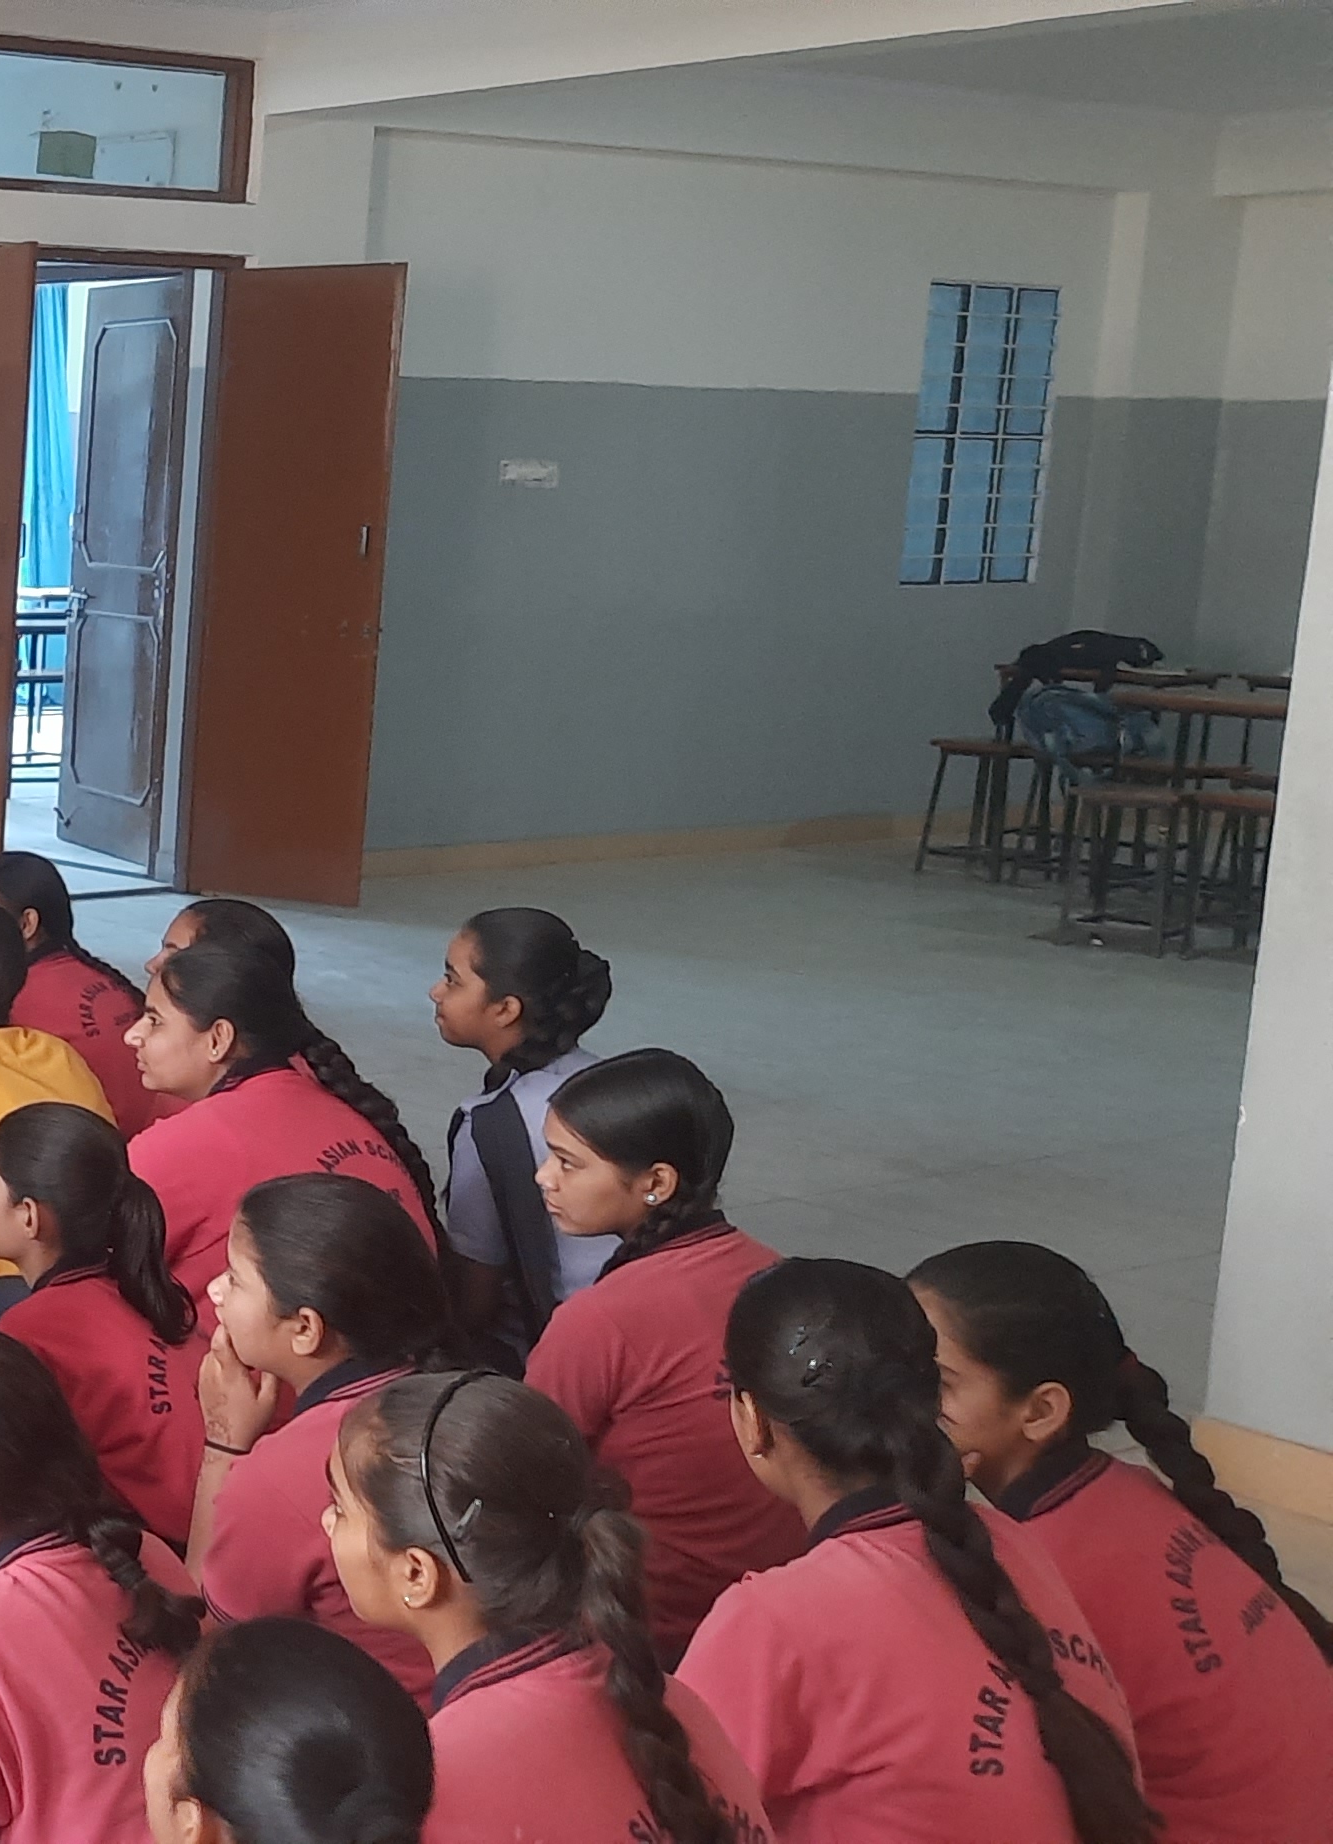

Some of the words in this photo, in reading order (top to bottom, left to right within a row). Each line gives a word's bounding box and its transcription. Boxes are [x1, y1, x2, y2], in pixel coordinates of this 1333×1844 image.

[316, 1139, 363, 1173] ASIAN
[148, 1355, 173, 1415] STAR
[1170, 1596, 1223, 1674] STAR
[93, 1679, 129, 1766] STAR
[969, 1685, 1012, 1777] STAR
